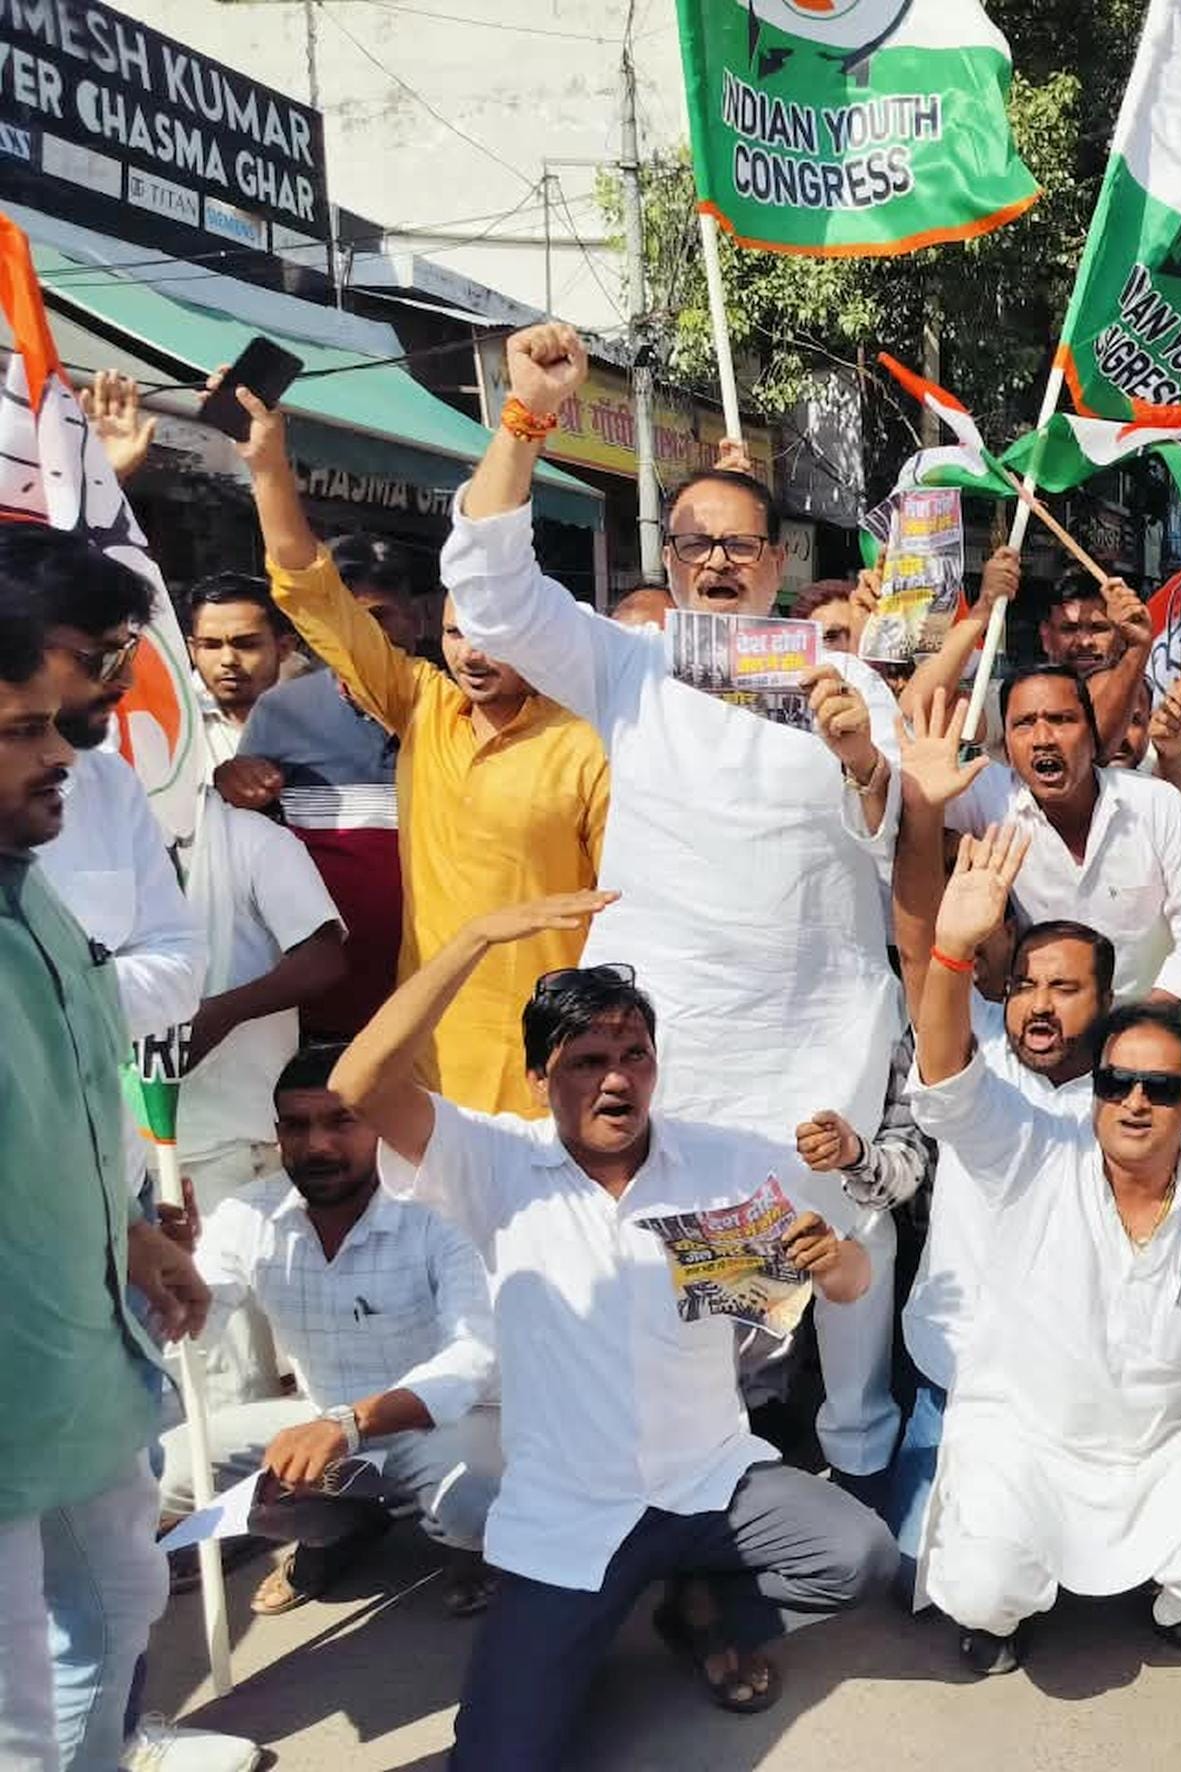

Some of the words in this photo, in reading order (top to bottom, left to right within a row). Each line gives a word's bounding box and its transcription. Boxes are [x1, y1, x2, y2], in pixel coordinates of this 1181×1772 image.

[0, 0, 151, 91] MESH
[161, 44, 314, 167] KUMAR
[76, 79, 228, 187] CHASMA
[235, 150, 314, 222] GHAR
[823, 94, 943, 154] YOUTH
[150, 183, 198, 219] TITAN
[734, 143, 914, 208] CONGRESS
